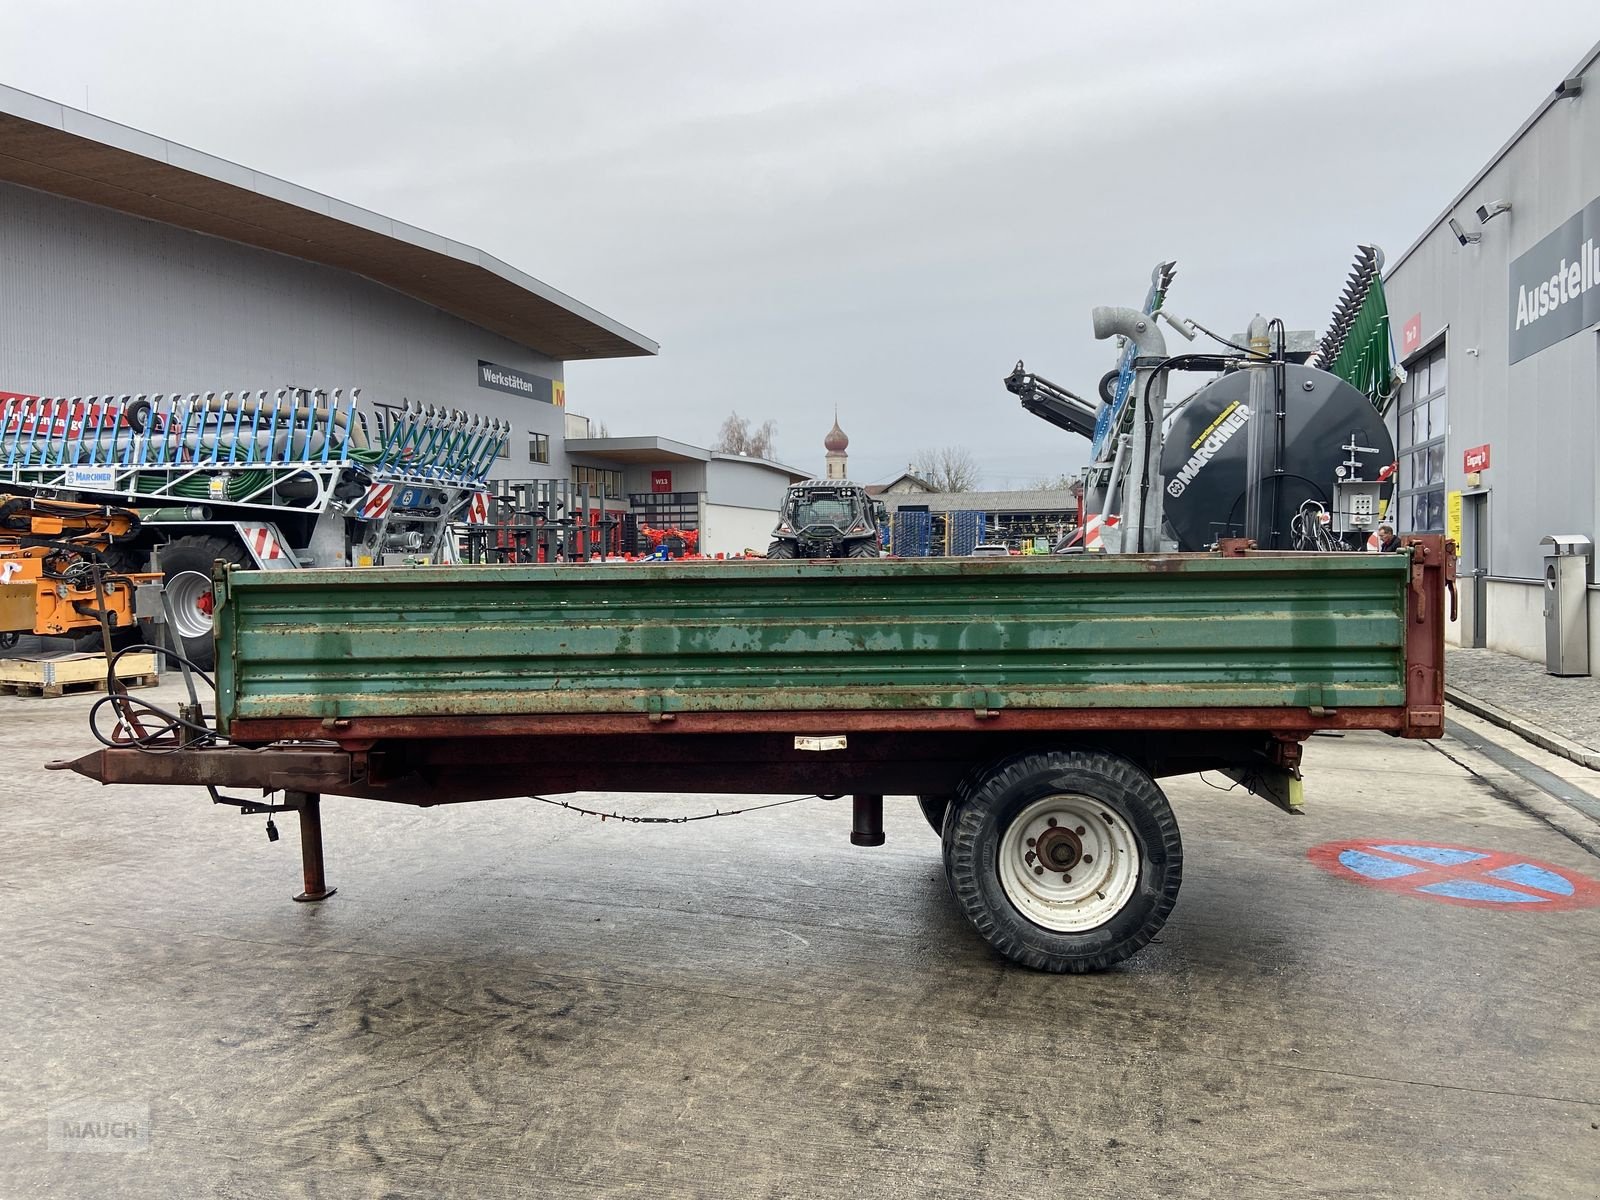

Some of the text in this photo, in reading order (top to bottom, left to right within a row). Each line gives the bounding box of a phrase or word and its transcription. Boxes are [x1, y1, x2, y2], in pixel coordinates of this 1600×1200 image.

[482, 367, 534, 393] Werkstätten
[1176, 404, 1256, 486] MARCHNER
[75, 472, 112, 481] MARCHNER
